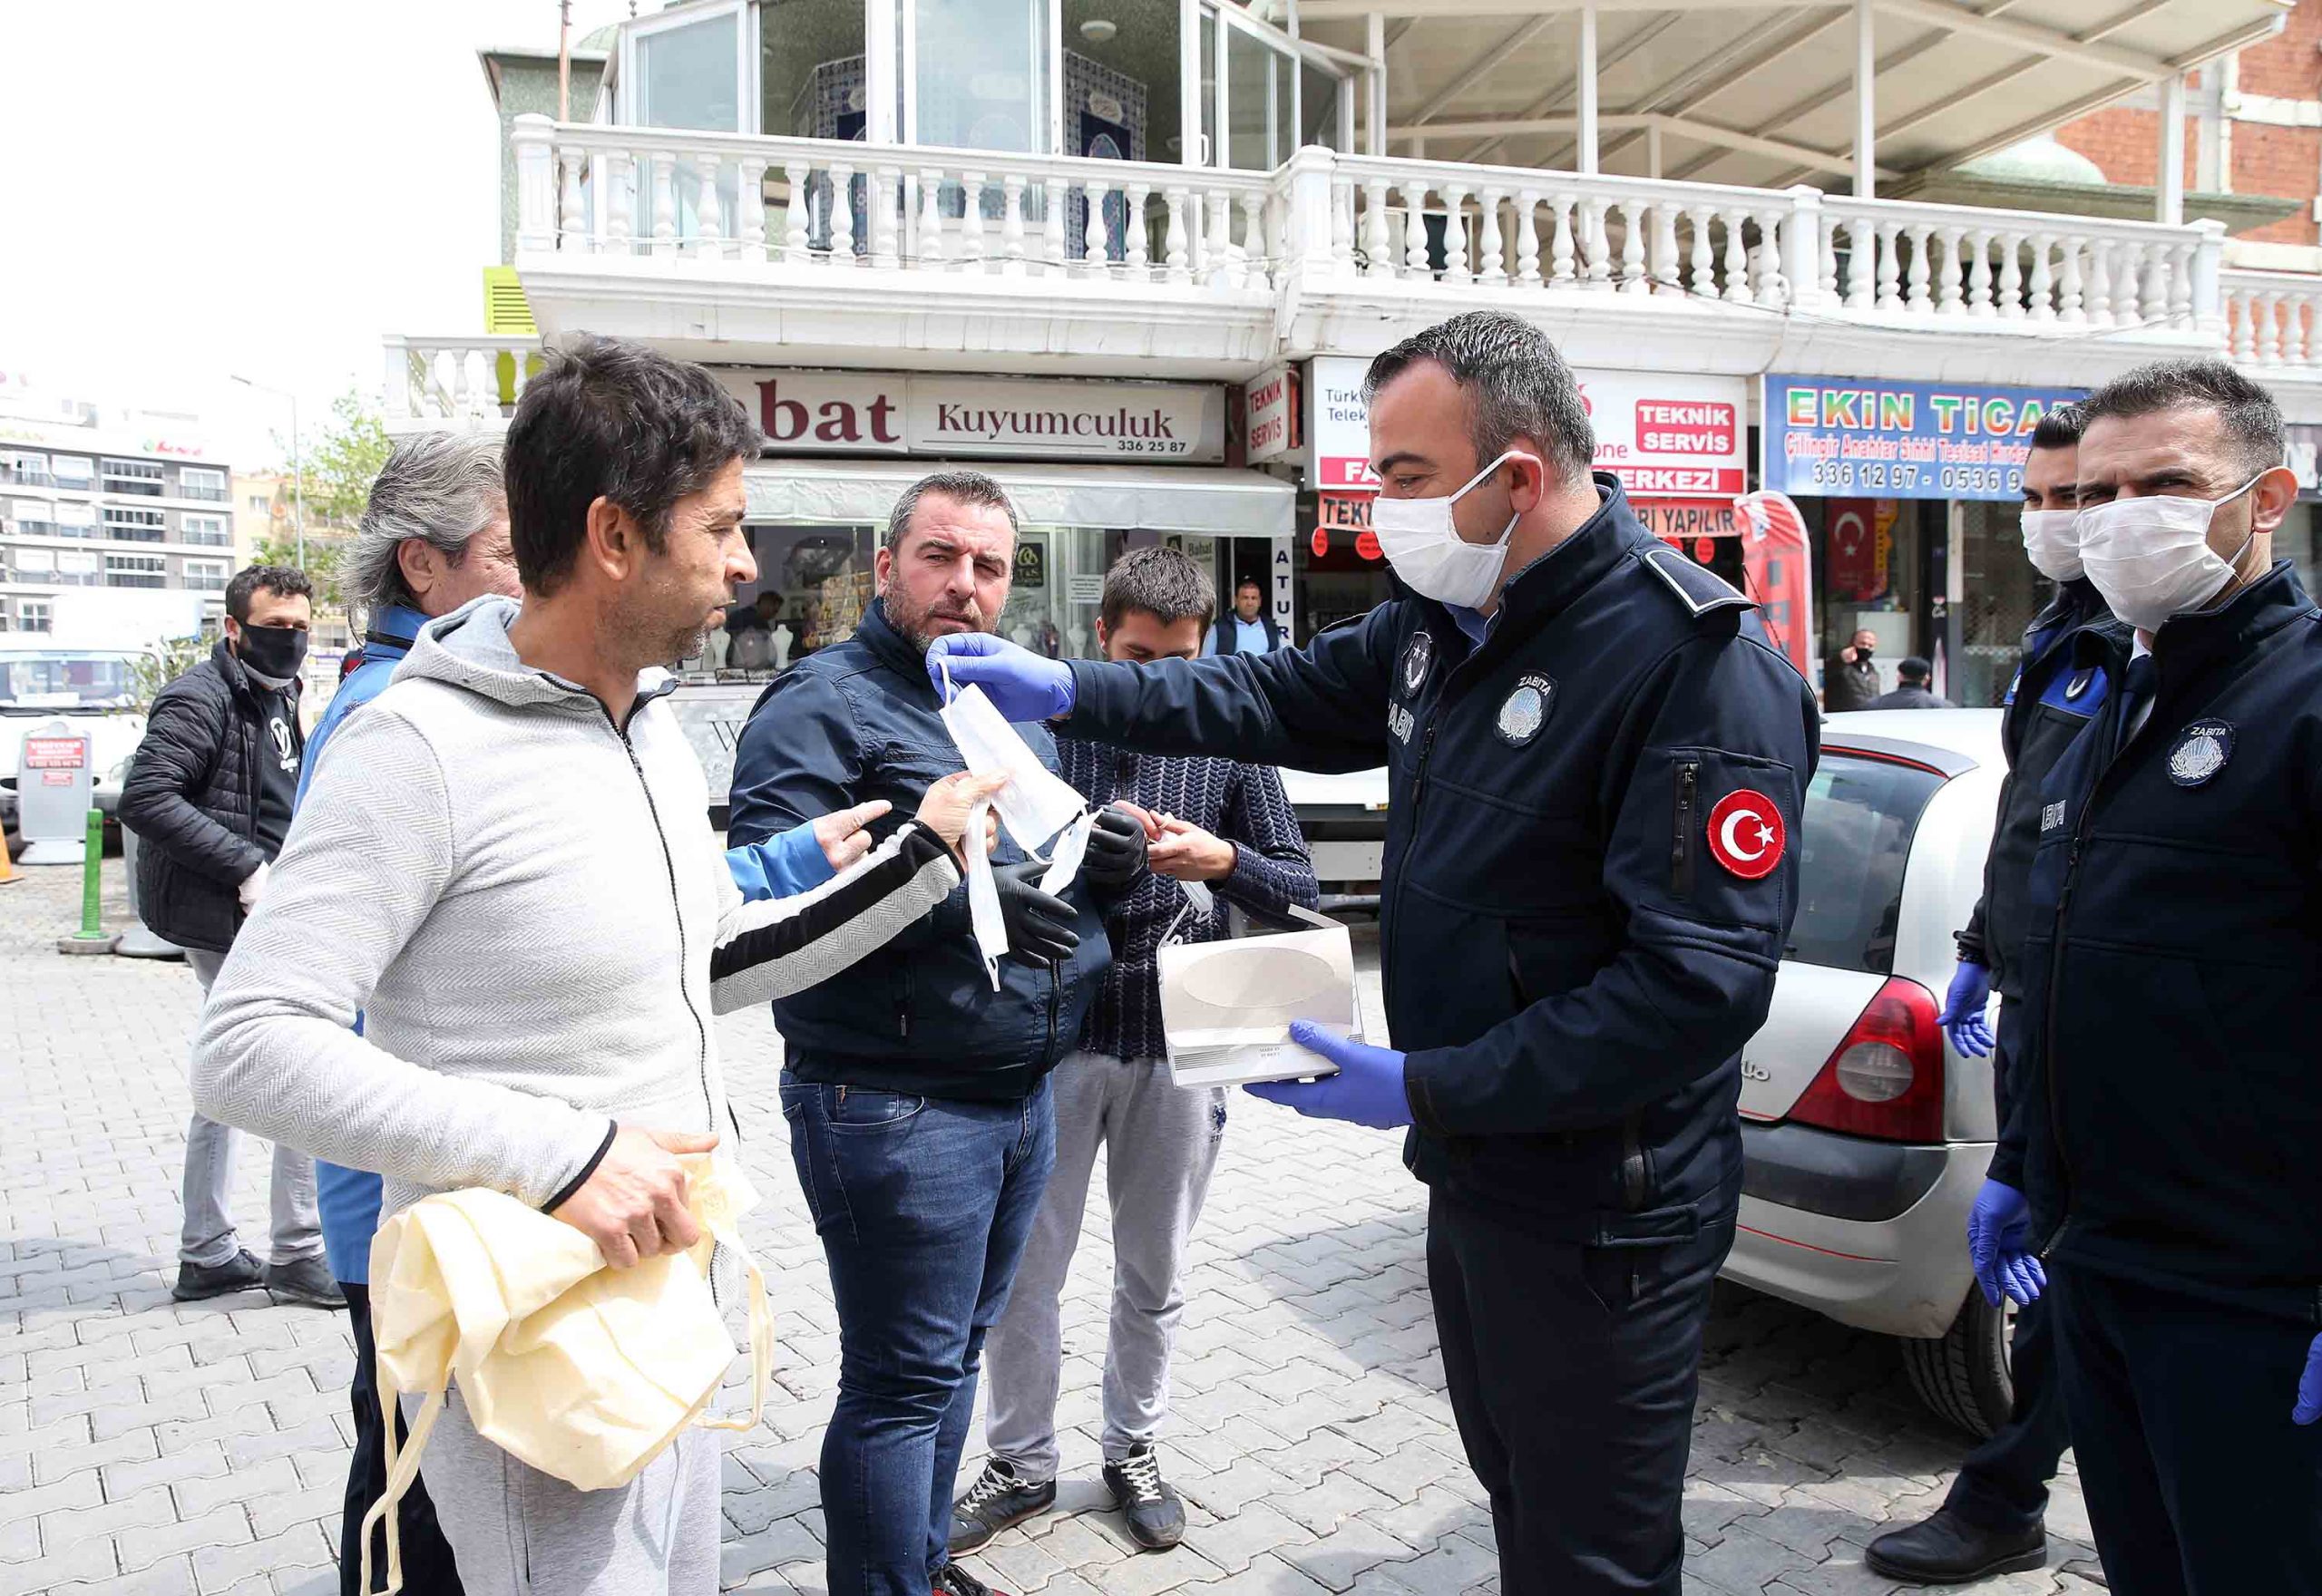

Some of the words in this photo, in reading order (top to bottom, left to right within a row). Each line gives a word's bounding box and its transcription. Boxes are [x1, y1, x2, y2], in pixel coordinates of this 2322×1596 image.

[1325, 388, 1358, 403] Türk
[733, 379, 901, 443] bat
[938, 404, 1174, 440] Kuyumculuk
[1637, 404, 1731, 427] TEKNİK
[1117, 440, 1145, 452] 336
[1148, 442, 1165, 453] 25
[1170, 442, 1187, 453] 87
[1643, 431, 1730, 453] SERVİS
[1814, 462, 1854, 487] 336
[1860, 464, 1886, 488] 12
[1890, 465, 1918, 490] 97
[1940, 467, 2001, 493] 0536
[1663, 507, 1736, 533] YAPILIR
[1517, 675, 1553, 697] ZABITA
[2190, 726, 2227, 736] ZABITA
